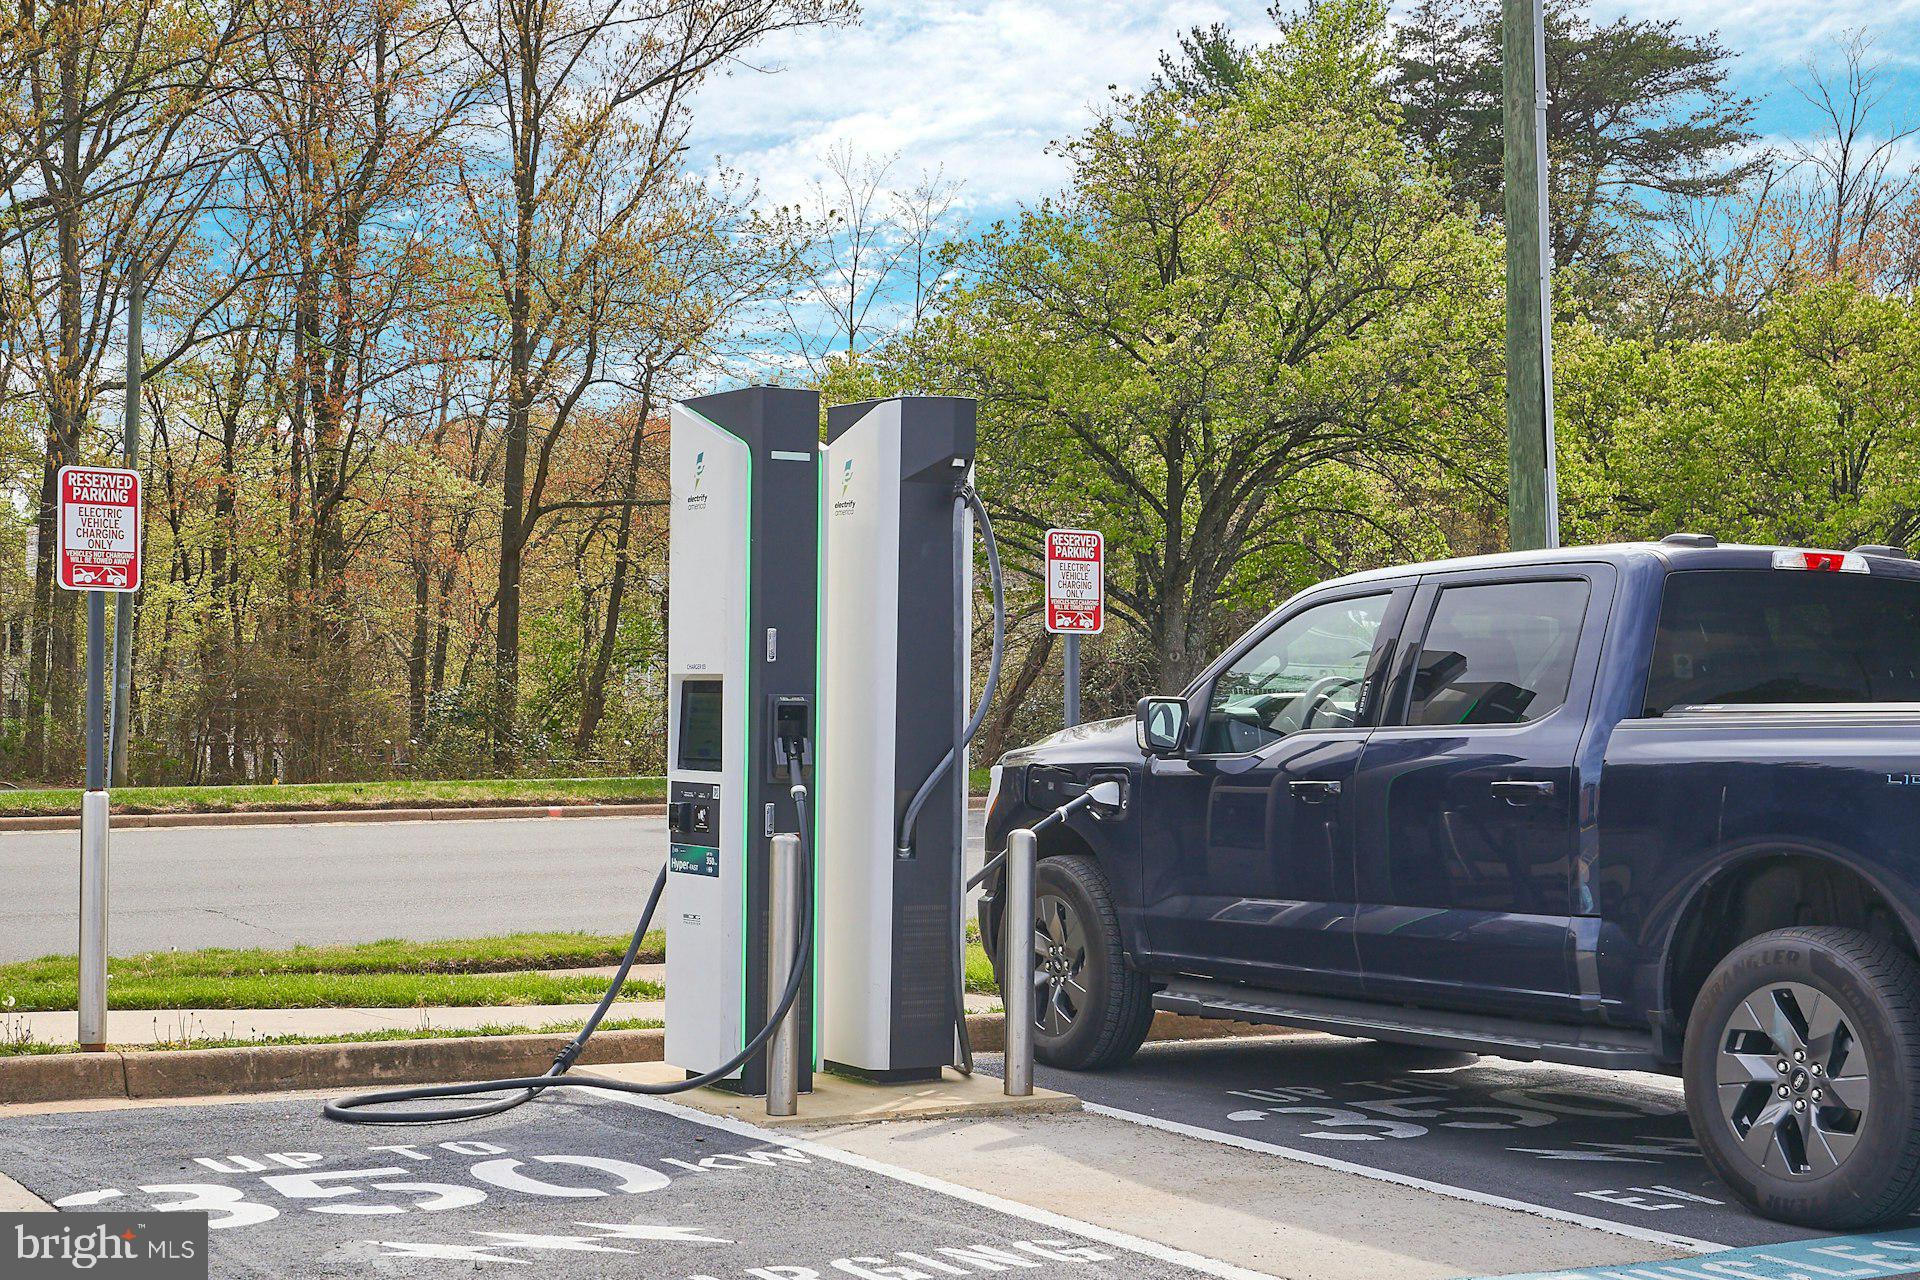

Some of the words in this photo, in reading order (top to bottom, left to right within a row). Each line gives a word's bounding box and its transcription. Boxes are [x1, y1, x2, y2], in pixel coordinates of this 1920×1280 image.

[68, 472, 133, 490] RESERVED
[72, 487, 129, 503] PARKING
[688, 494, 707, 502] electrify
[835, 500, 855, 508] electrify
[78, 507, 122, 519] ELECTRIC
[81, 518, 120, 529] VEHICLE
[76, 528, 125, 540] CHARGING
[87, 539, 113, 549] ONLY
[1052, 534, 1098, 547] RESERVED
[1055, 546, 1095, 559] PARKING
[1059, 563, 1091, 572] ELECTRIC
[1061, 572, 1088, 580] VEHICLE
[1058, 581, 1092, 590] CHARGING
[1066, 589, 1084, 598] ONLY
[1226, 1085, 1332, 1102] UP
[193, 1152, 324, 1173] UP
[367, 1141, 508, 1161] TO
[52, 1154, 672, 1230] 350
[659, 1149, 812, 1172] KW
[1573, 1185, 1726, 1211] EV
